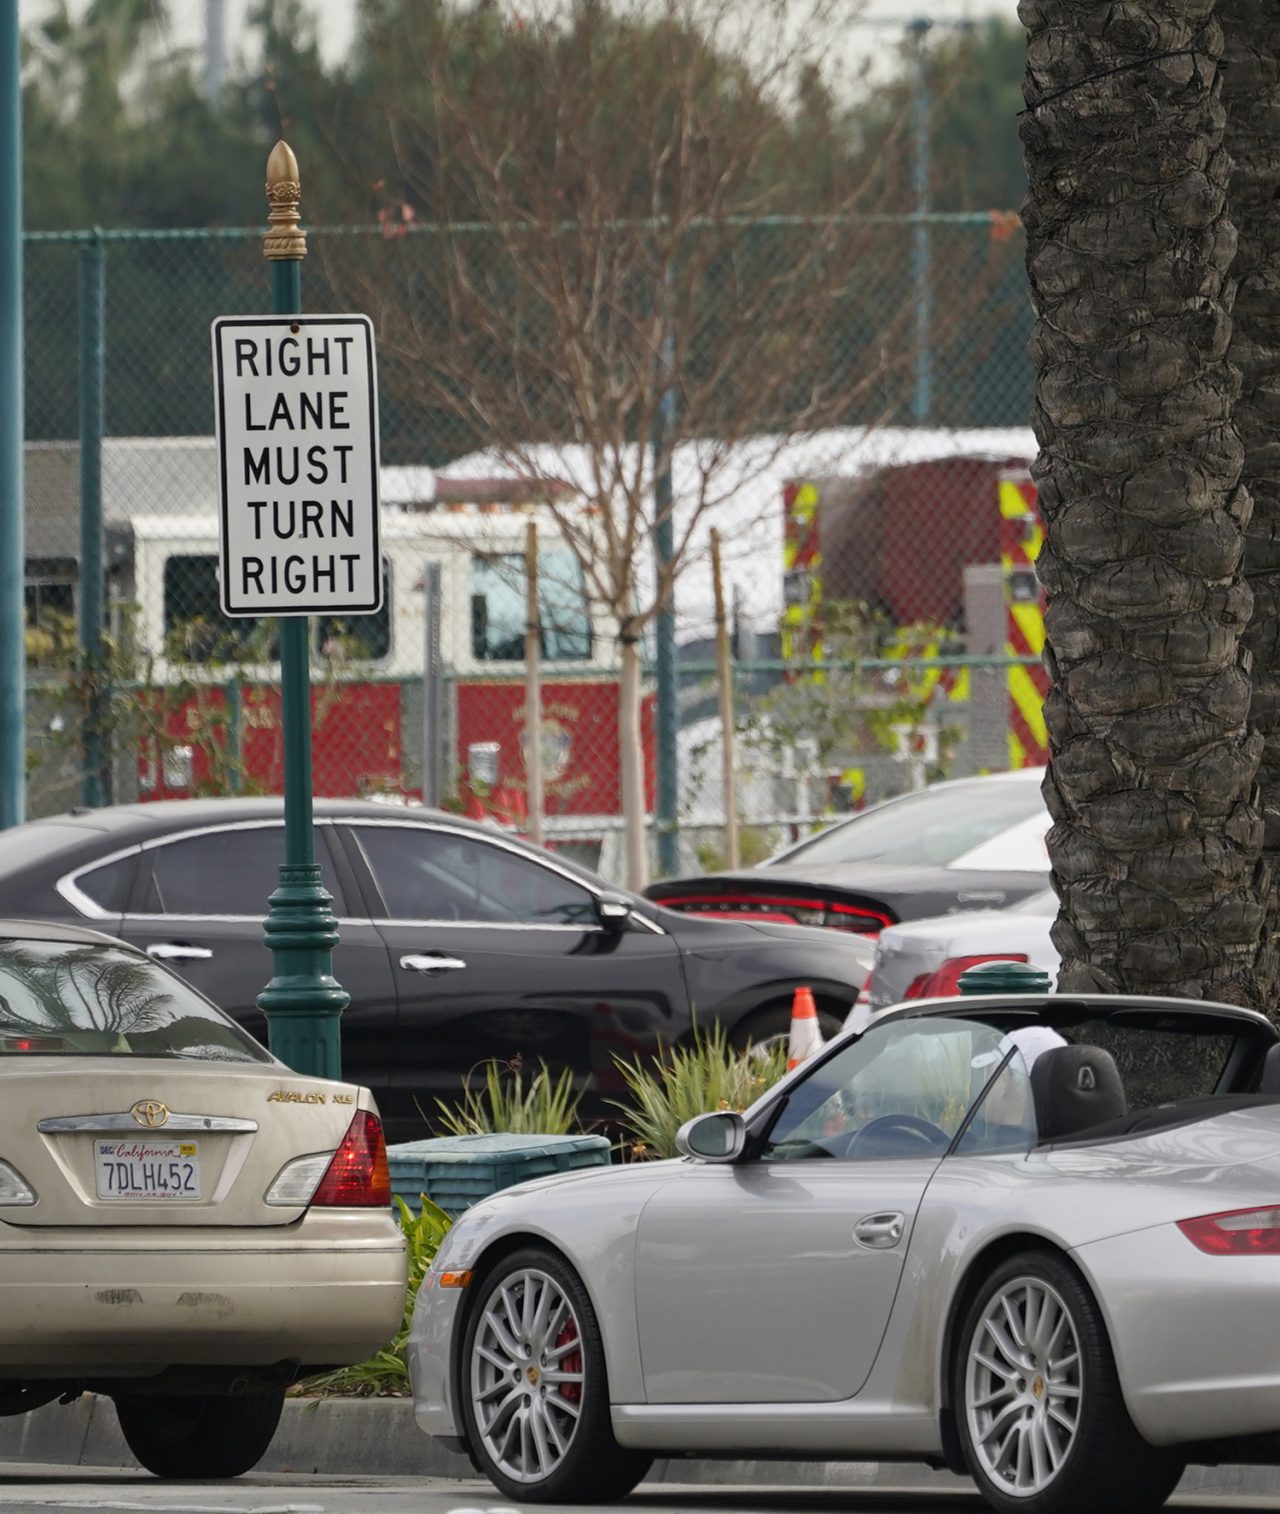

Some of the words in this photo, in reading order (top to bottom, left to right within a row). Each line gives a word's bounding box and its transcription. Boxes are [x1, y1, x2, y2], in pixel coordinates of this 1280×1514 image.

[236, 338, 354, 377] RIGHT
[244, 391, 350, 431] LANE
[243, 445, 353, 486] MUST
[247, 500, 355, 540] TURN
[241, 554, 361, 595] RIGHT
[266, 1090, 327, 1105] AVALON
[116, 1143, 181, 1161] California
[103, 1162, 196, 1191] 7DLH452
